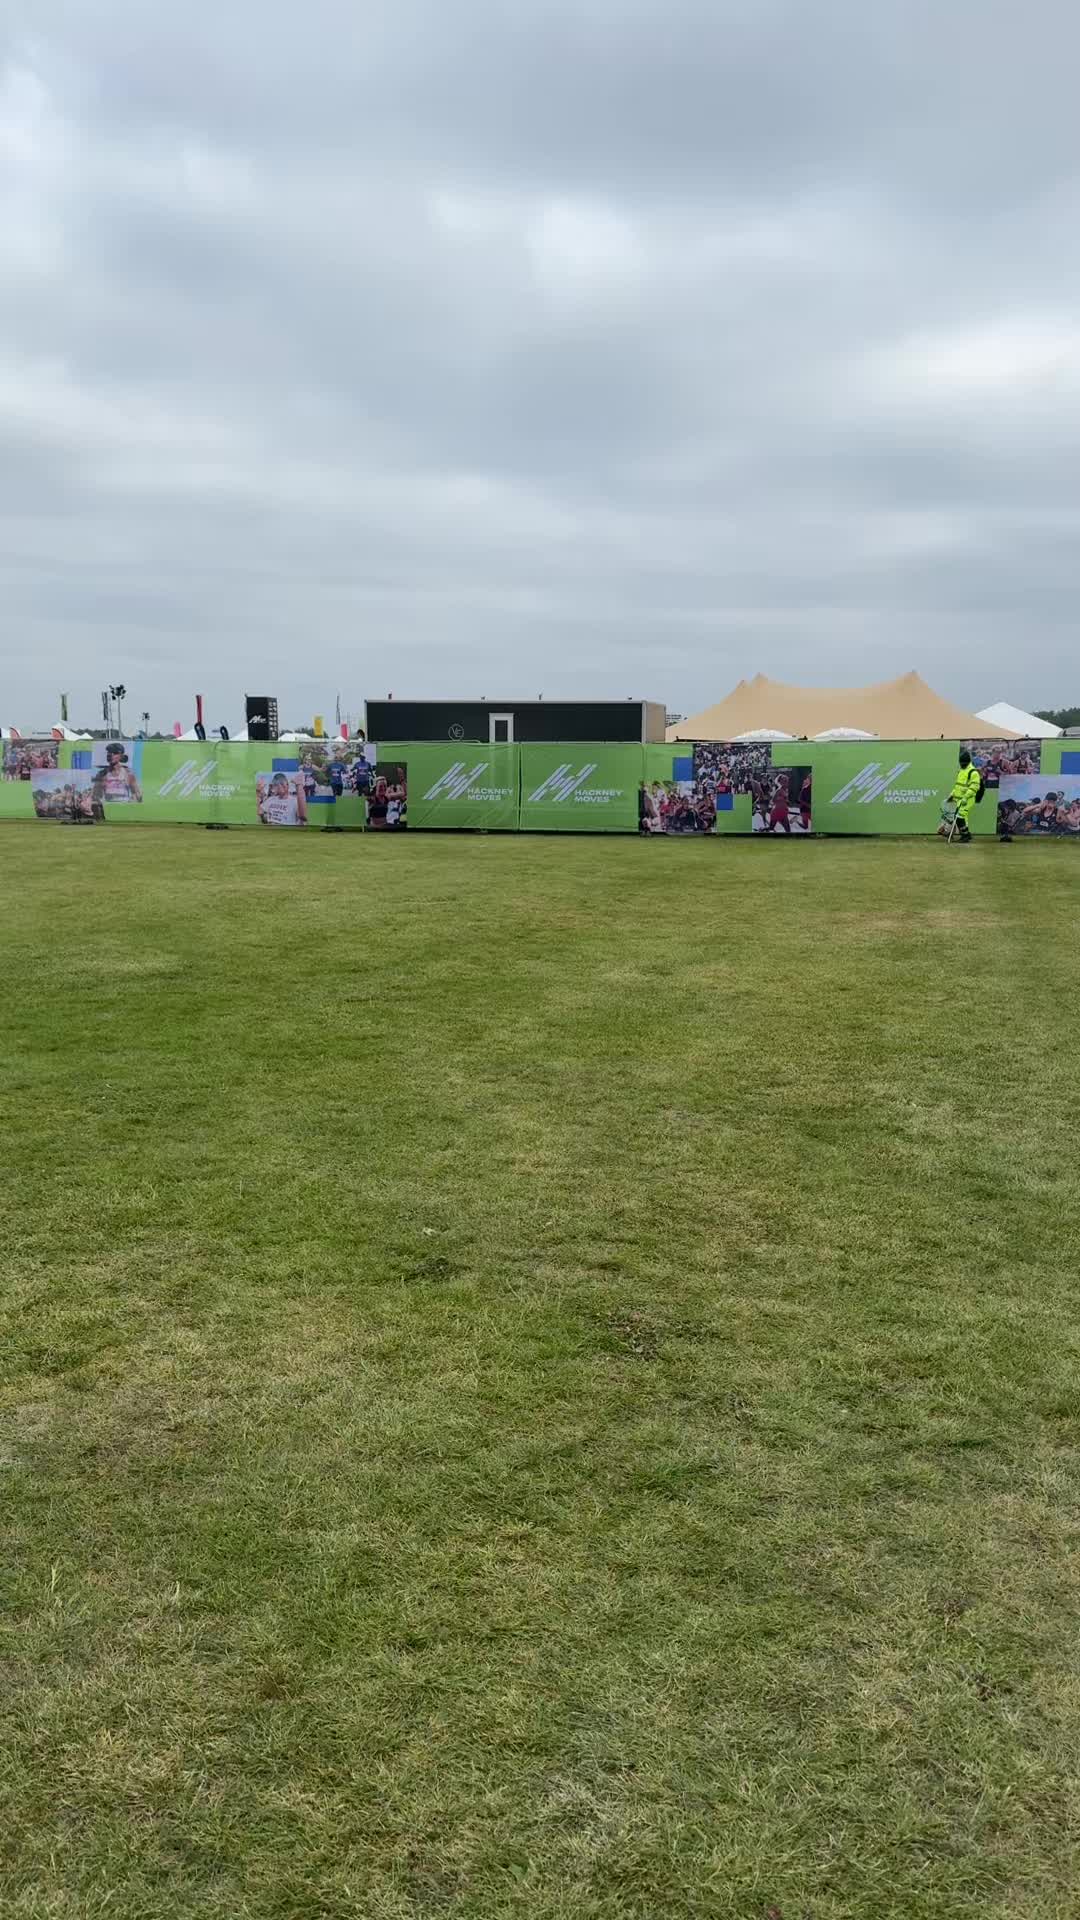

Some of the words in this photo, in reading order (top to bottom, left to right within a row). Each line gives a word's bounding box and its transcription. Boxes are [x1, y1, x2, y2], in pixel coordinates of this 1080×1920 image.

[467, 787, 513, 795] HACKNEY
[575, 788, 624, 796] HACKNEY
[884, 788, 938, 796] HACKNEY
